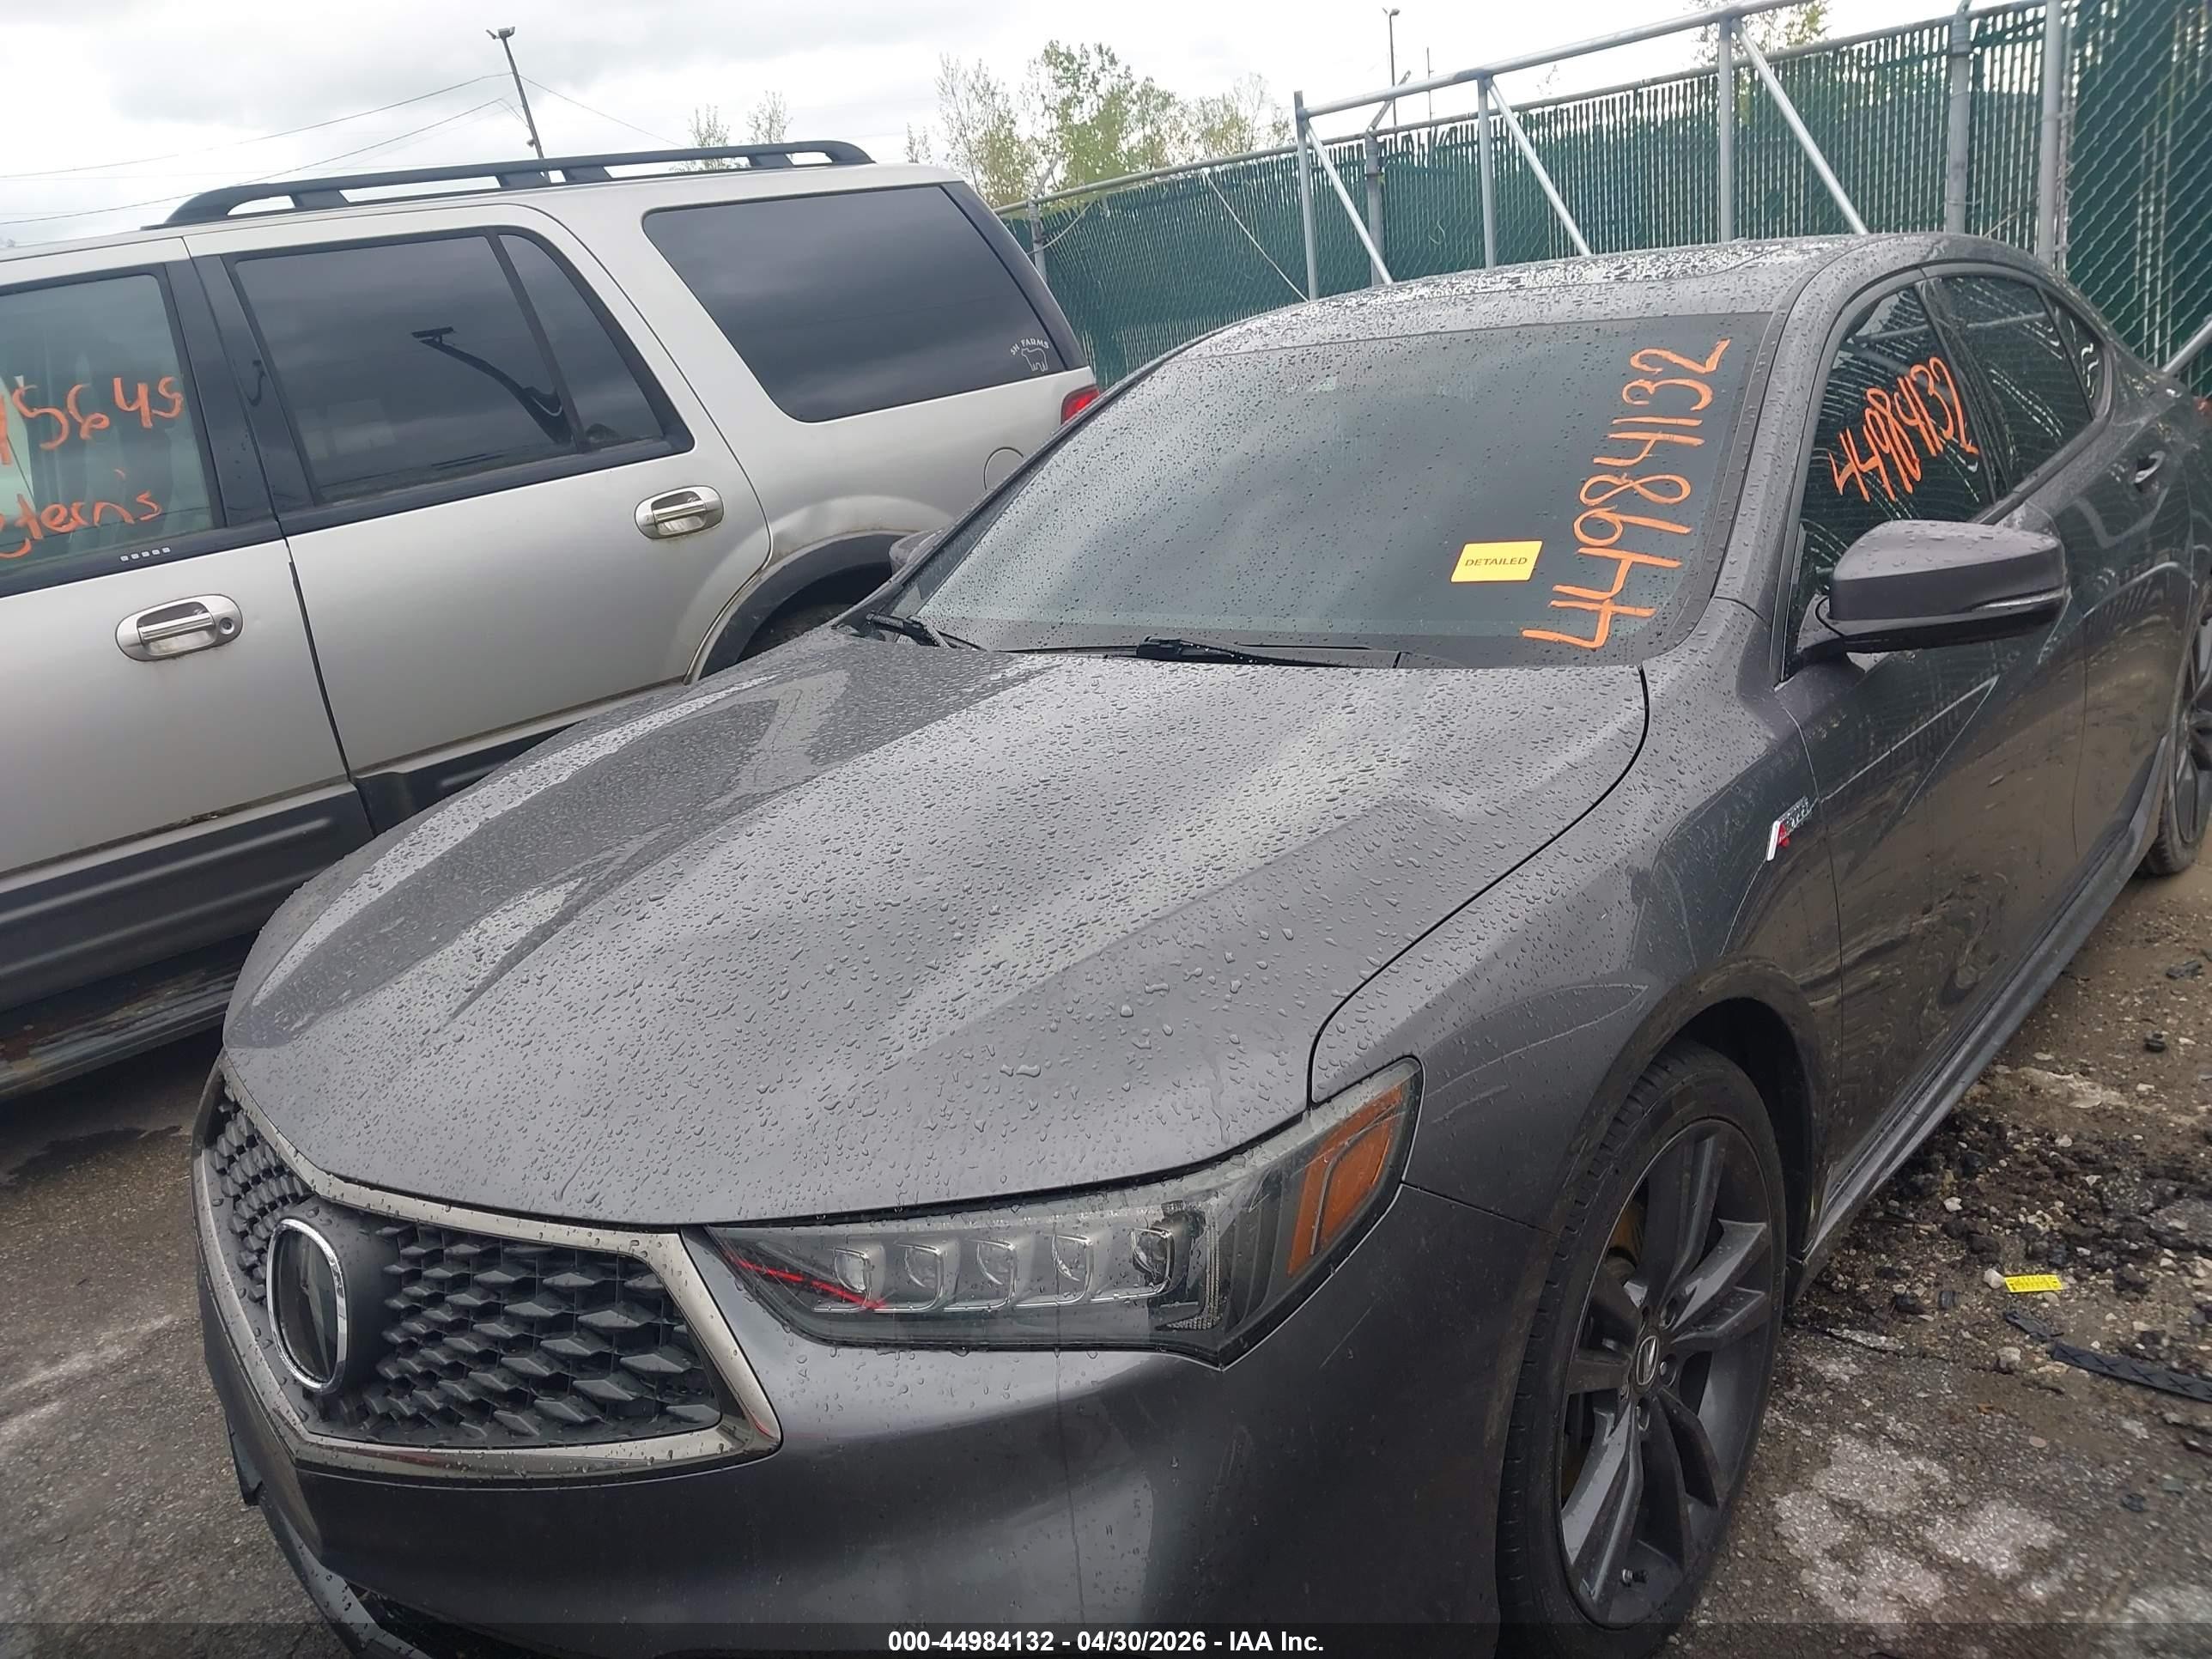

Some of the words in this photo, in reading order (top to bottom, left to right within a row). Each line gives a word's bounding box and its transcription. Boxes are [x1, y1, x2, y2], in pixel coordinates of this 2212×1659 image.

[1021, 337, 1049, 349] FARMS
[1520, 337, 1731, 649] 44984132
[1464, 556, 1528, 567] DETAILED
